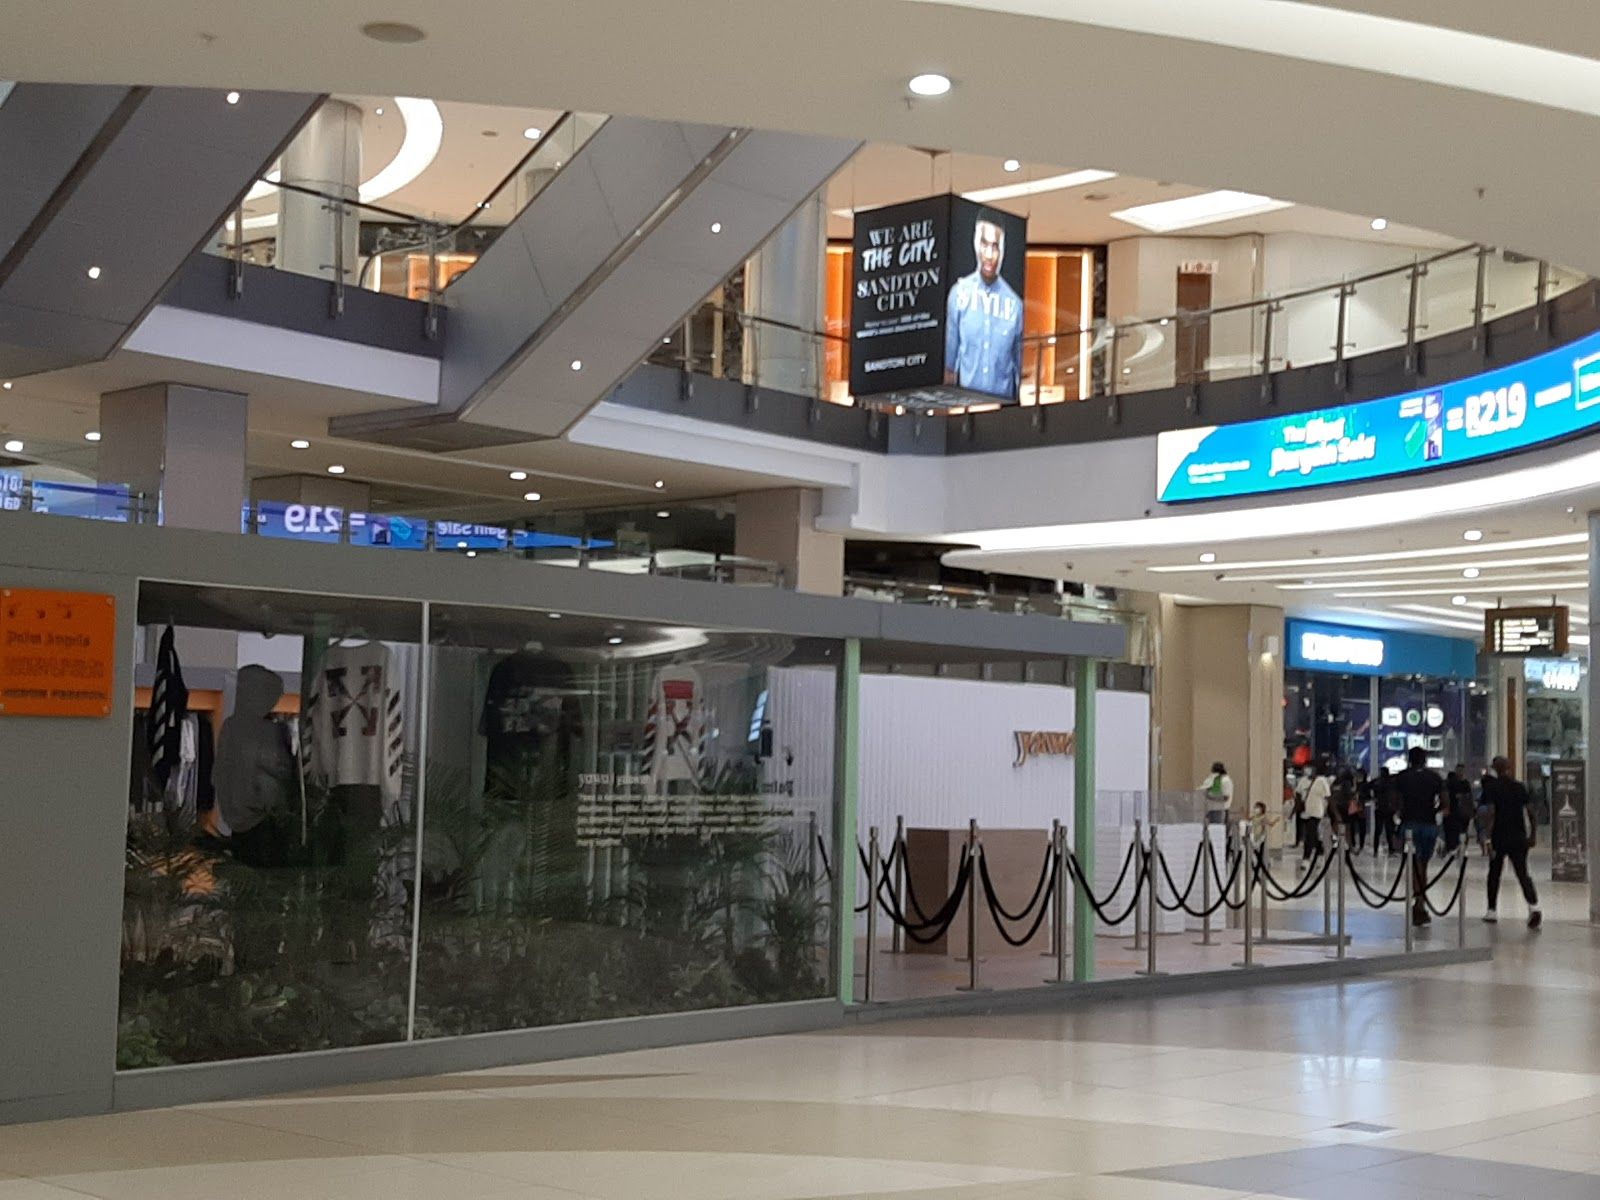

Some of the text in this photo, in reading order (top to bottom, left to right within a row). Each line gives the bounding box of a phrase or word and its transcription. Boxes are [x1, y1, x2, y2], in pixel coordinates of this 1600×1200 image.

[869, 219, 933, 246] WE ARE
[862, 247, 893, 272] THE
[857, 267, 941, 298] SANDTON
[877, 288, 919, 312] CITY
